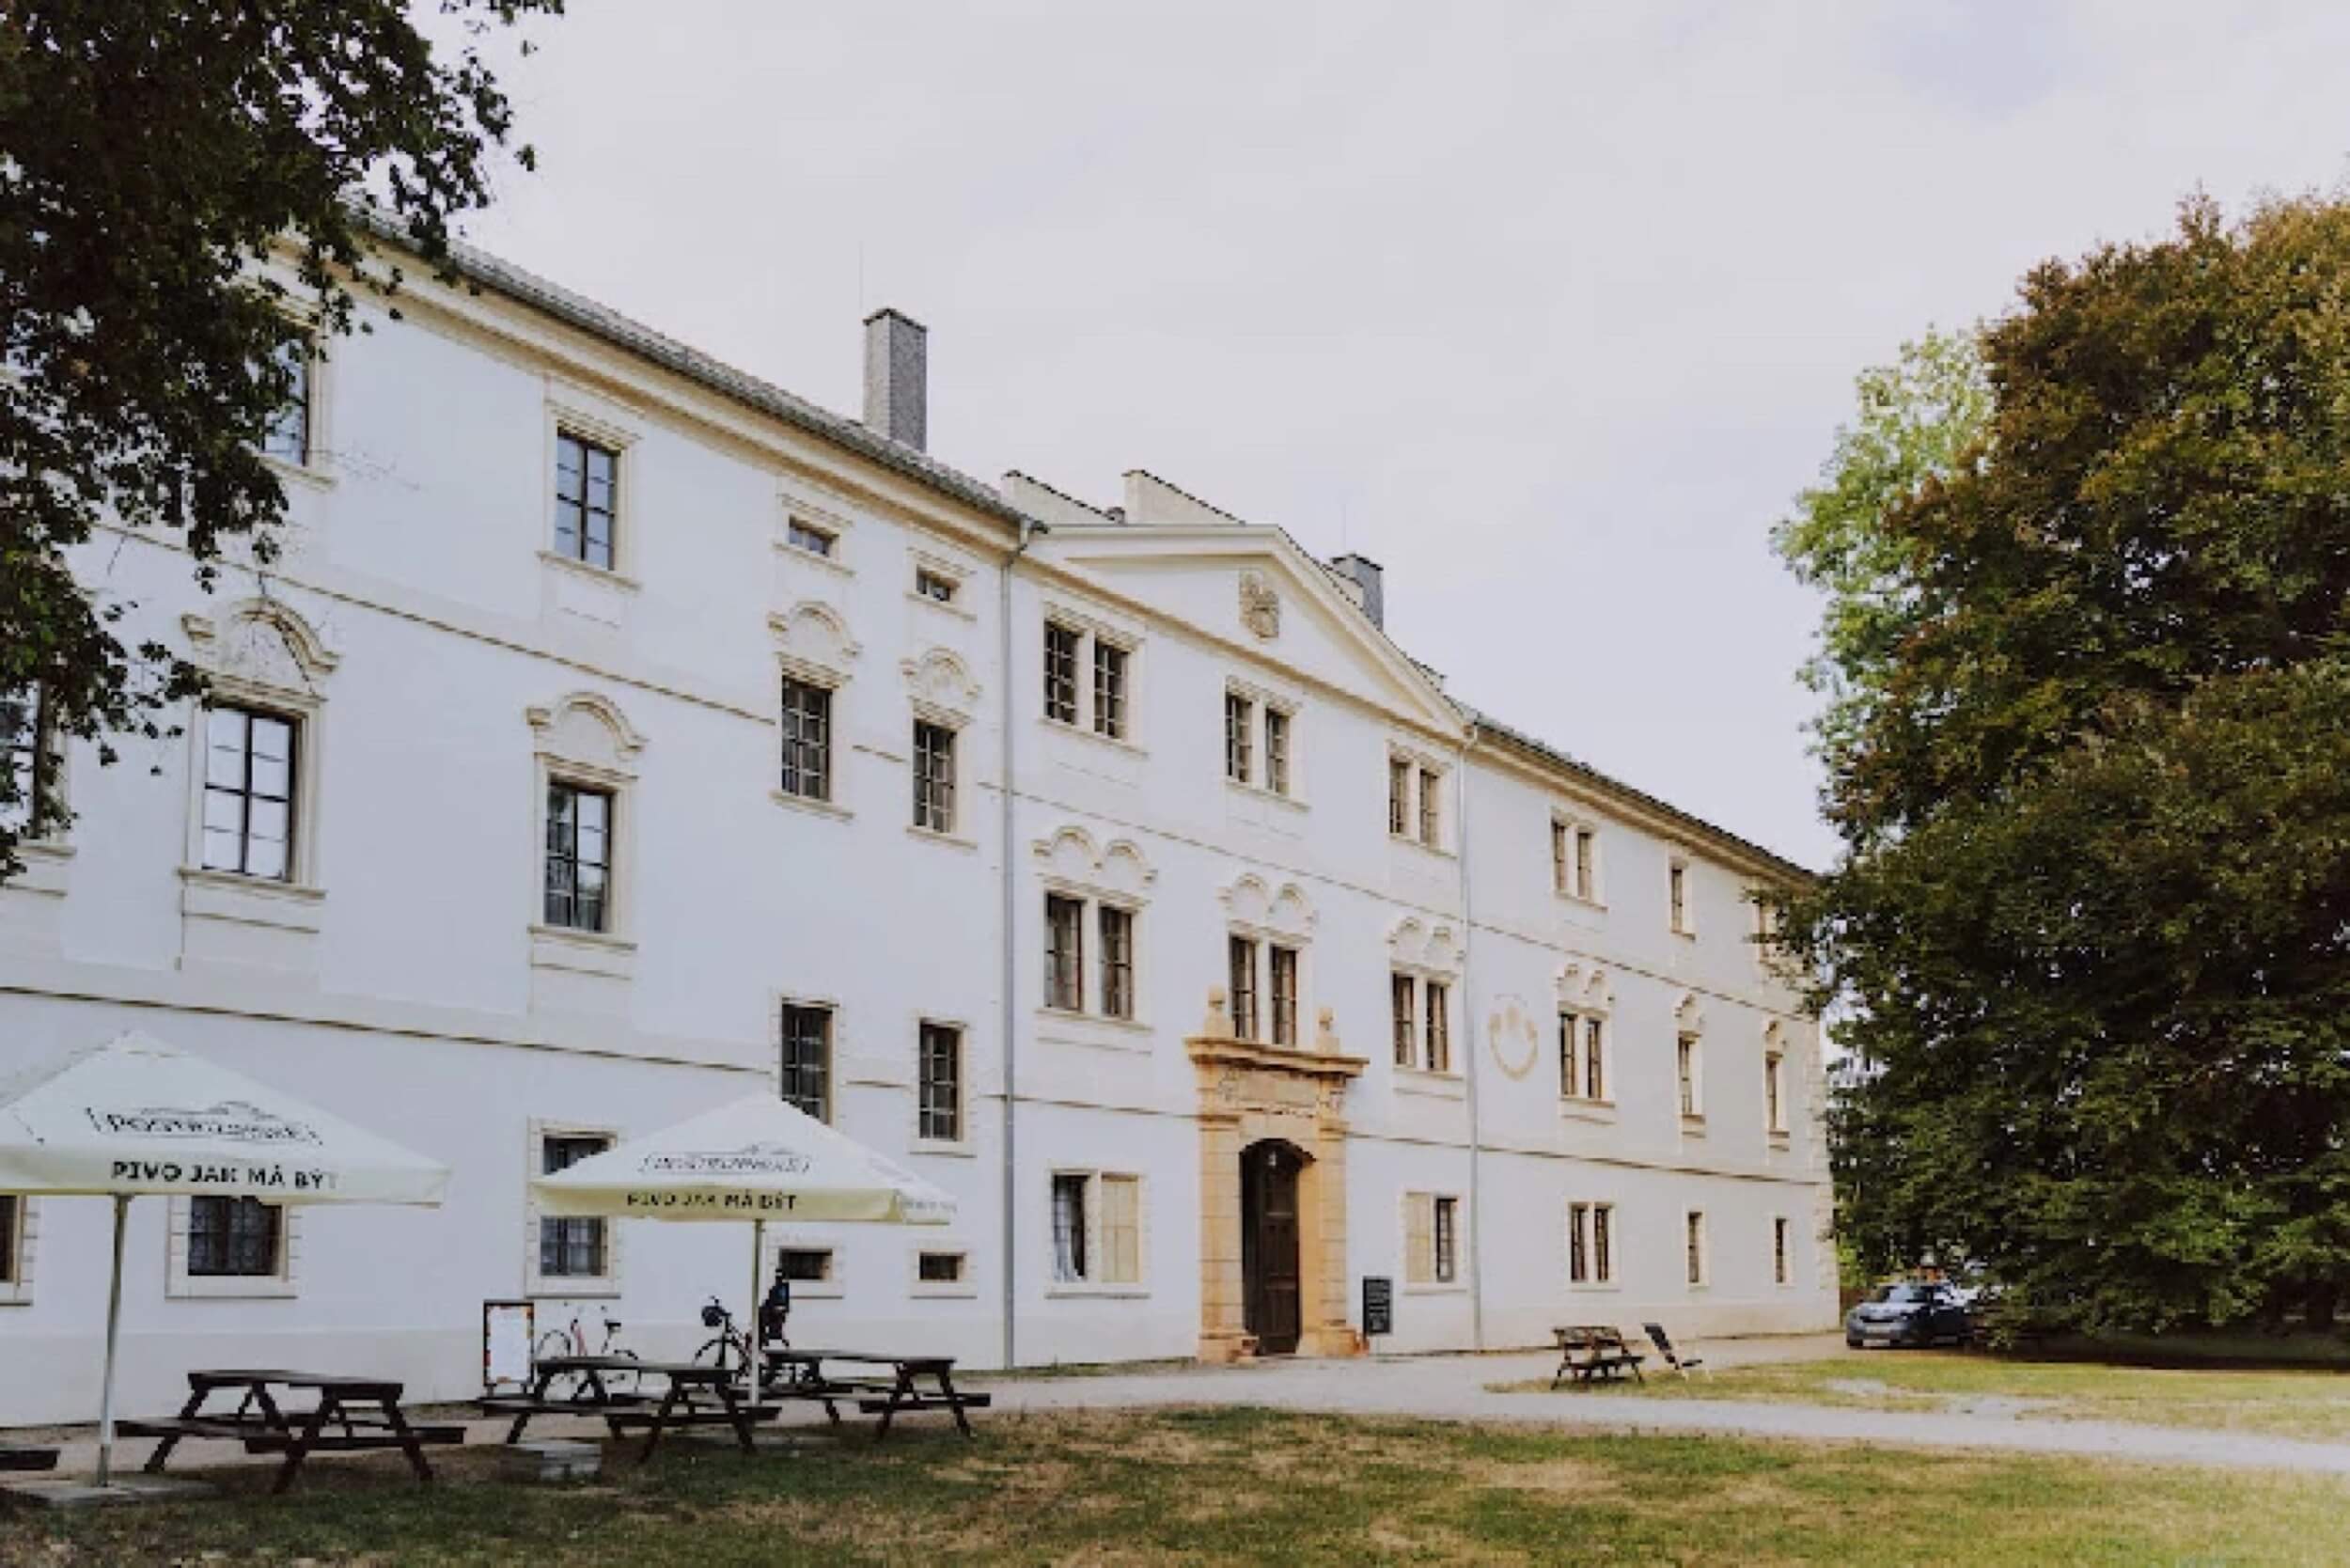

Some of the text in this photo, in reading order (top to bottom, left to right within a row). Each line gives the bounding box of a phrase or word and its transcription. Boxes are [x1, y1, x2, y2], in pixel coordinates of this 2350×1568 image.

[112, 1160, 182, 1182] PIVO
[190, 1164, 237, 1183] JAK
[248, 1163, 285, 1186] MÁ
